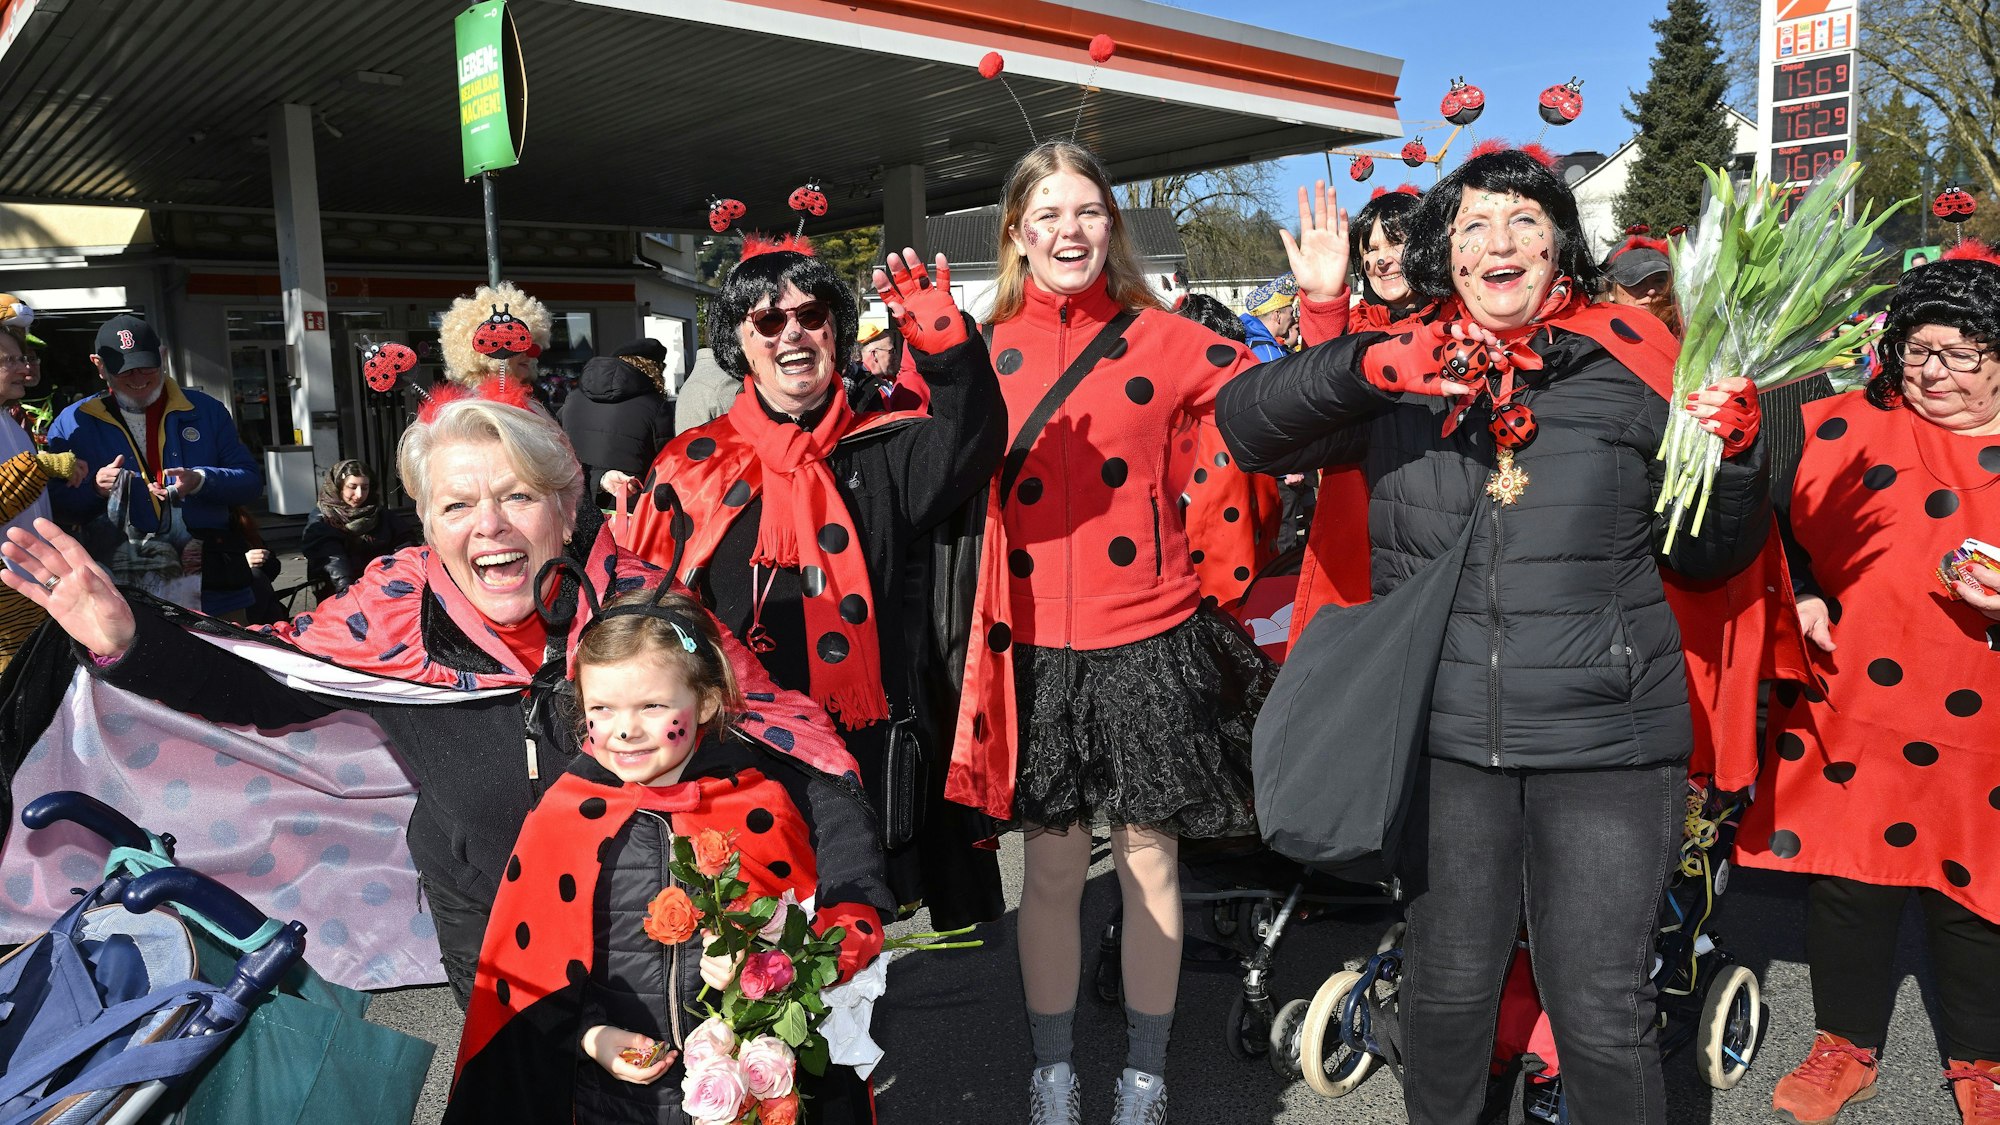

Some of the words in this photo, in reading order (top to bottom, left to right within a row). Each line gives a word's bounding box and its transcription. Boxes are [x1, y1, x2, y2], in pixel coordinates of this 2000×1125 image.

[459, 44, 498, 85] LEBEN:
[1781, 61, 1805, 72] Diesel
[461, 72, 499, 104] BEZAHLBAR
[462, 91, 501, 126] MACHEN!
[1780, 105, 1803, 114] Super
[1804, 101, 1821, 111] E10
[1778, 146, 1802, 155] Super
[117, 329, 135, 350] B
